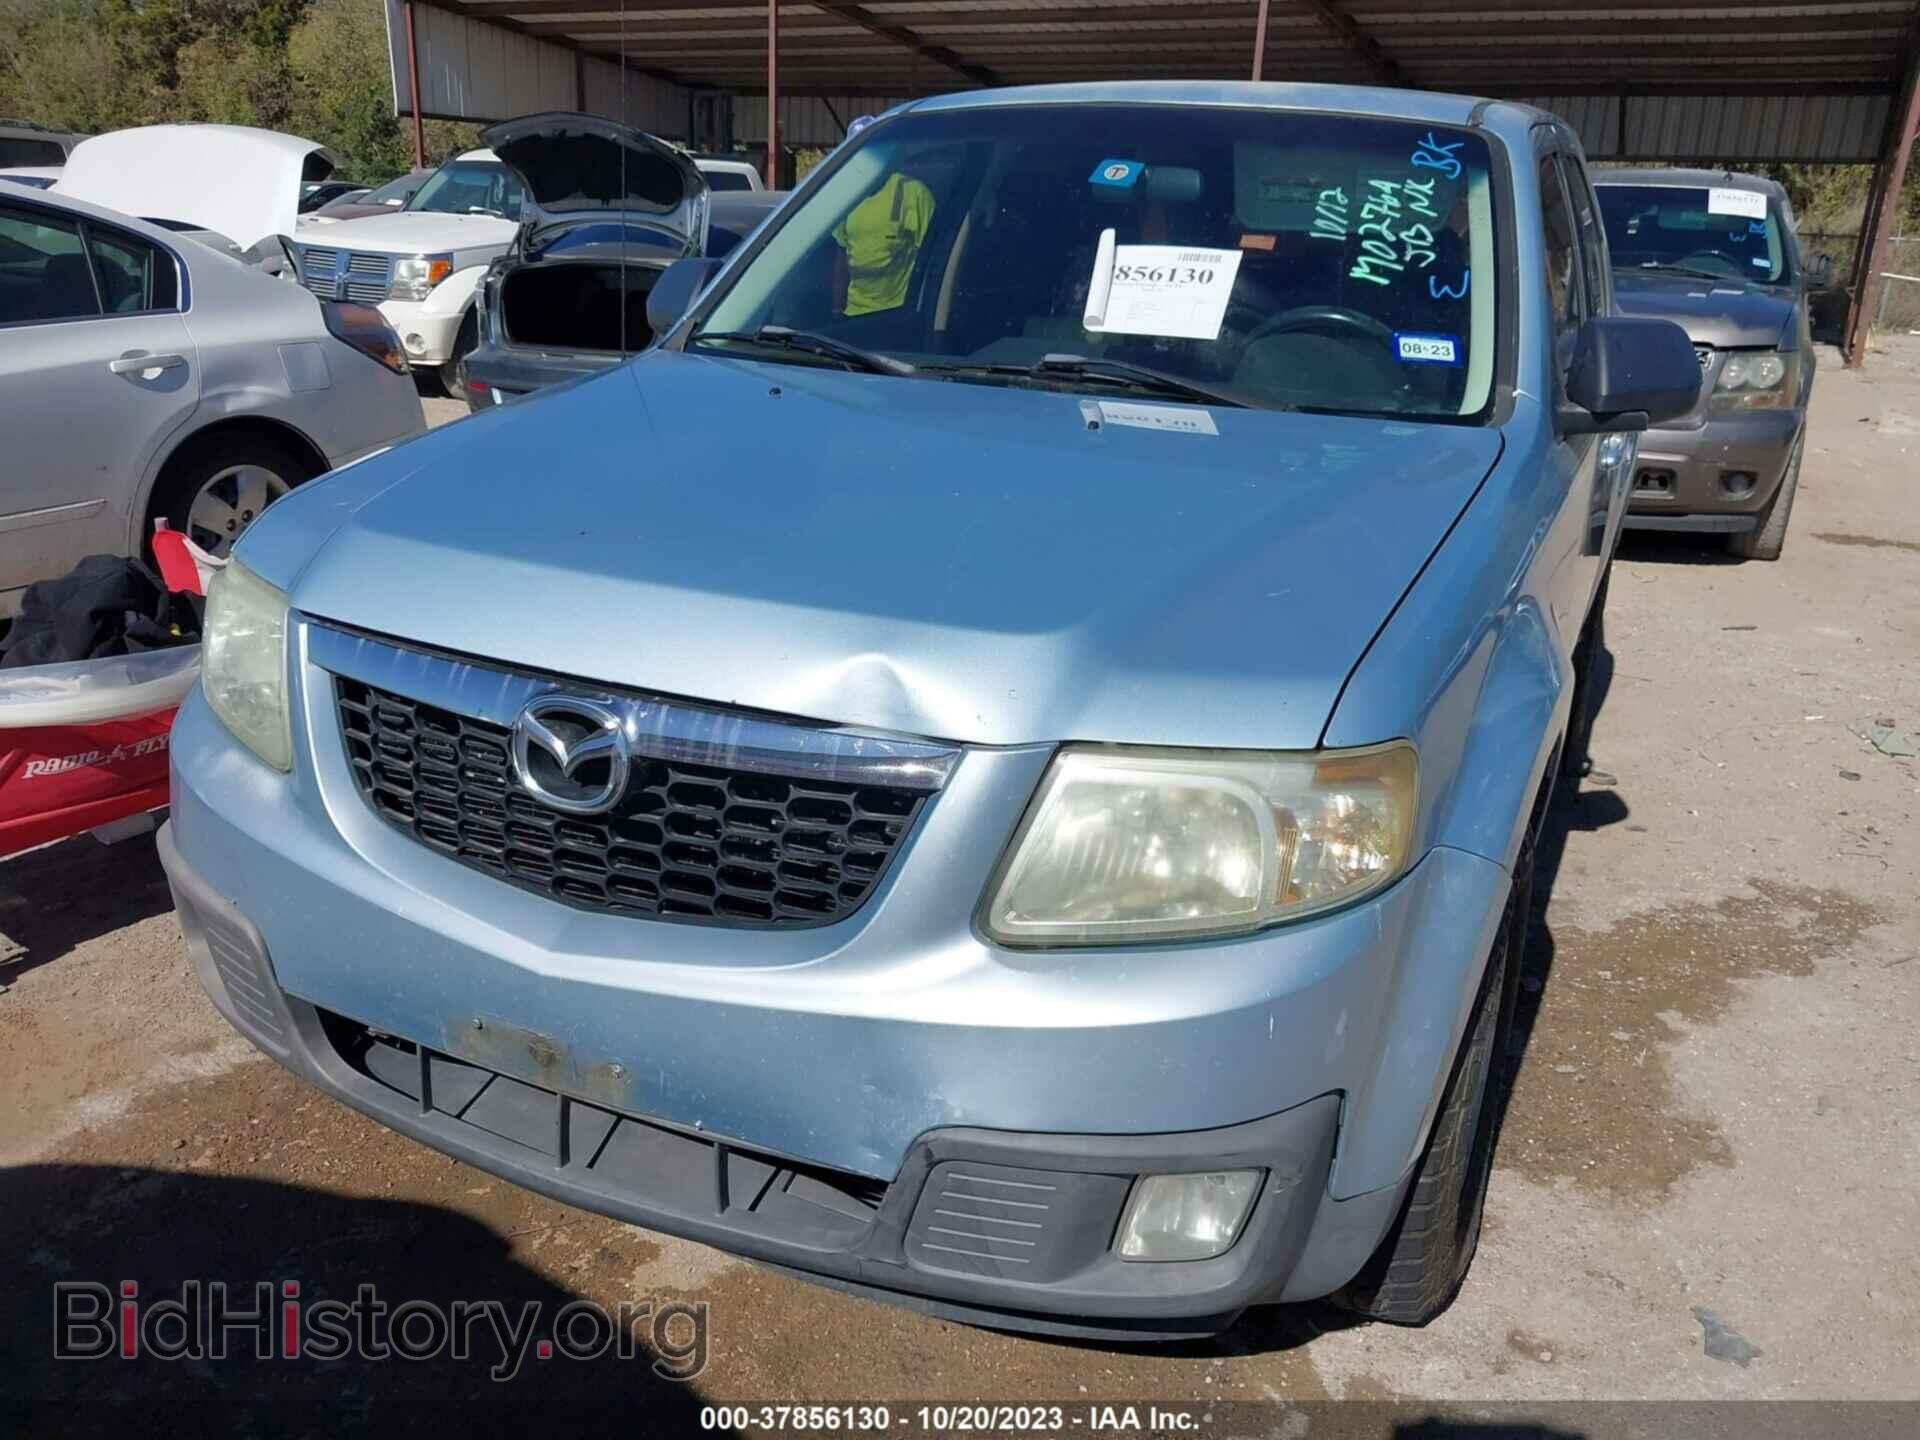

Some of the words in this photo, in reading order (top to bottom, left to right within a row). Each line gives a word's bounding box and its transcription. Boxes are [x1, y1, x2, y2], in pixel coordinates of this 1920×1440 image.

[1112, 264, 1215, 285] 856130
[1402, 342, 1422, 354] 08
[1430, 345, 1451, 356] 23
